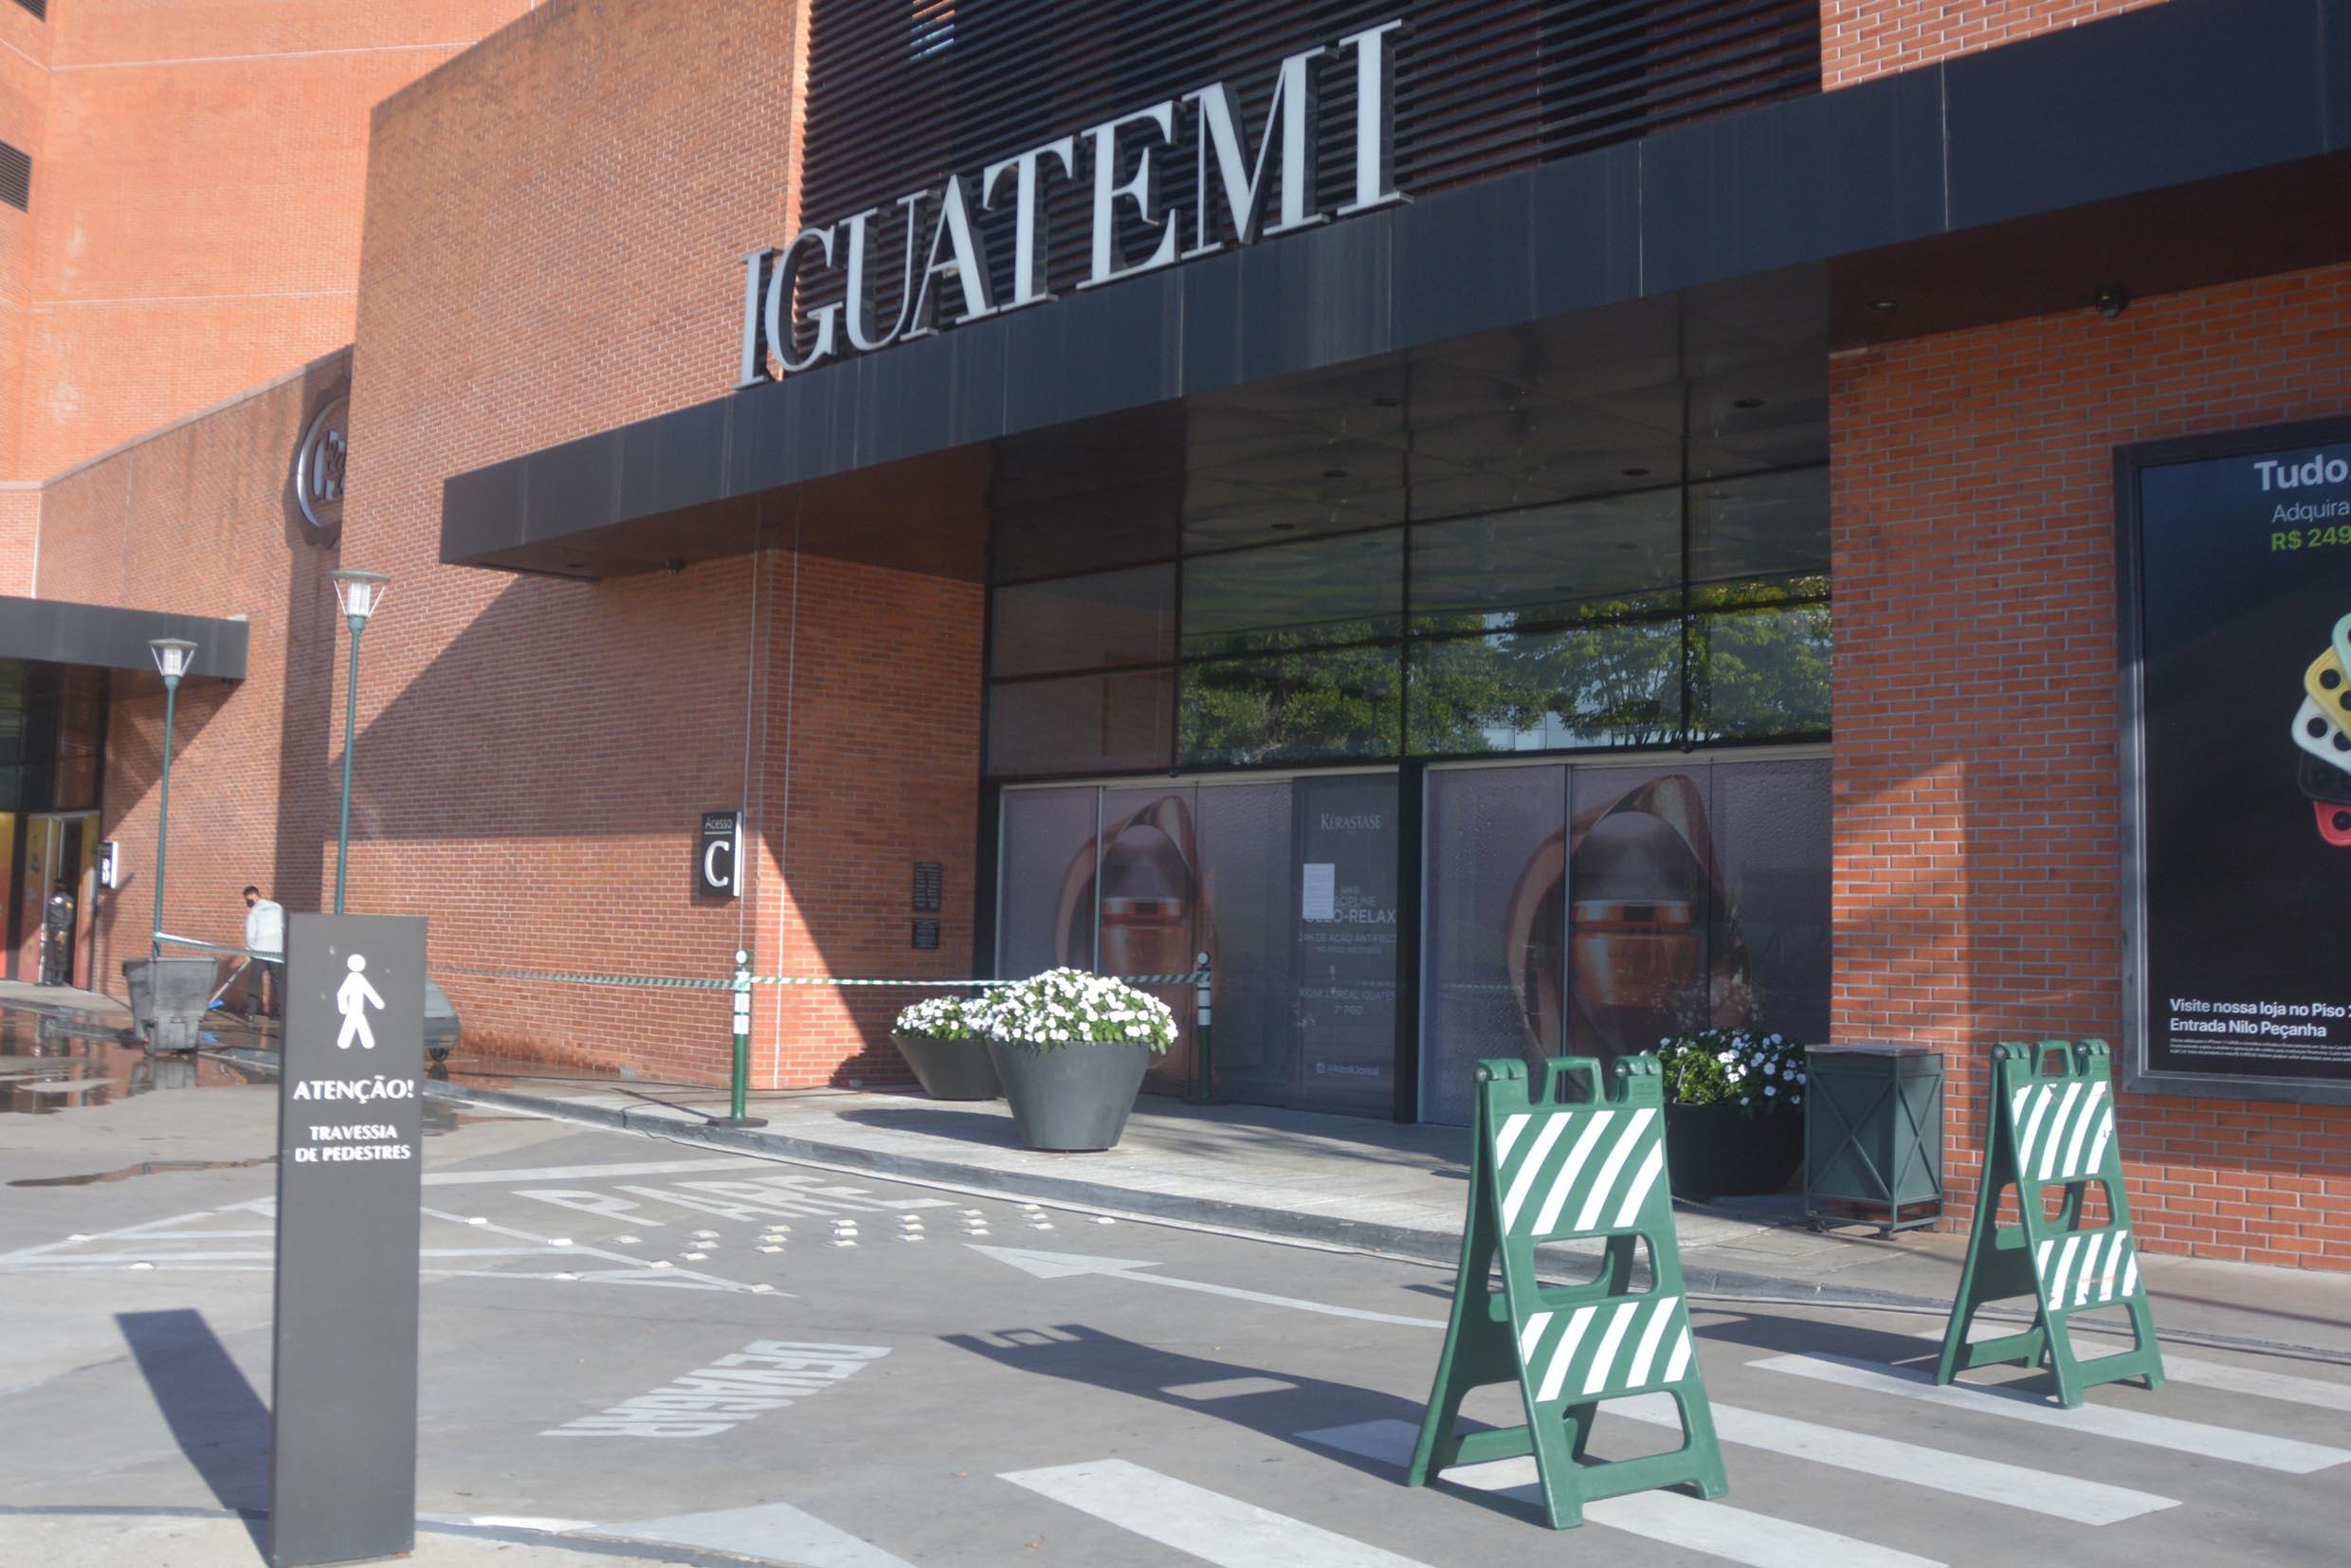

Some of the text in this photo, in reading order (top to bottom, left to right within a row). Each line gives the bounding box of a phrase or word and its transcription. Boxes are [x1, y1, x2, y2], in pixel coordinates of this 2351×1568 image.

[732, 19, 1414, 390] IGUATEMI
[2271, 499, 2350, 523] Adquira
[2271, 531, 2302, 552] R$
[705, 817, 732, 830] Acesso
[704, 840, 729, 887] C
[2170, 998, 2210, 1012] Visite
[2214, 1002, 2257, 1014] nossa
[2260, 1001, 2287, 1018] loja
[2289, 1004, 2309, 1016] no
[2312, 1003, 2345, 1017] Piso
[2170, 1018, 2327, 1039] Entrada Nilo Peçanha
[293, 1075, 414, 1104] ATENÇÃO!
[310, 1124, 398, 1141] TRAVESSIA
[295, 1144, 411, 1162] DE PEDESTRES
